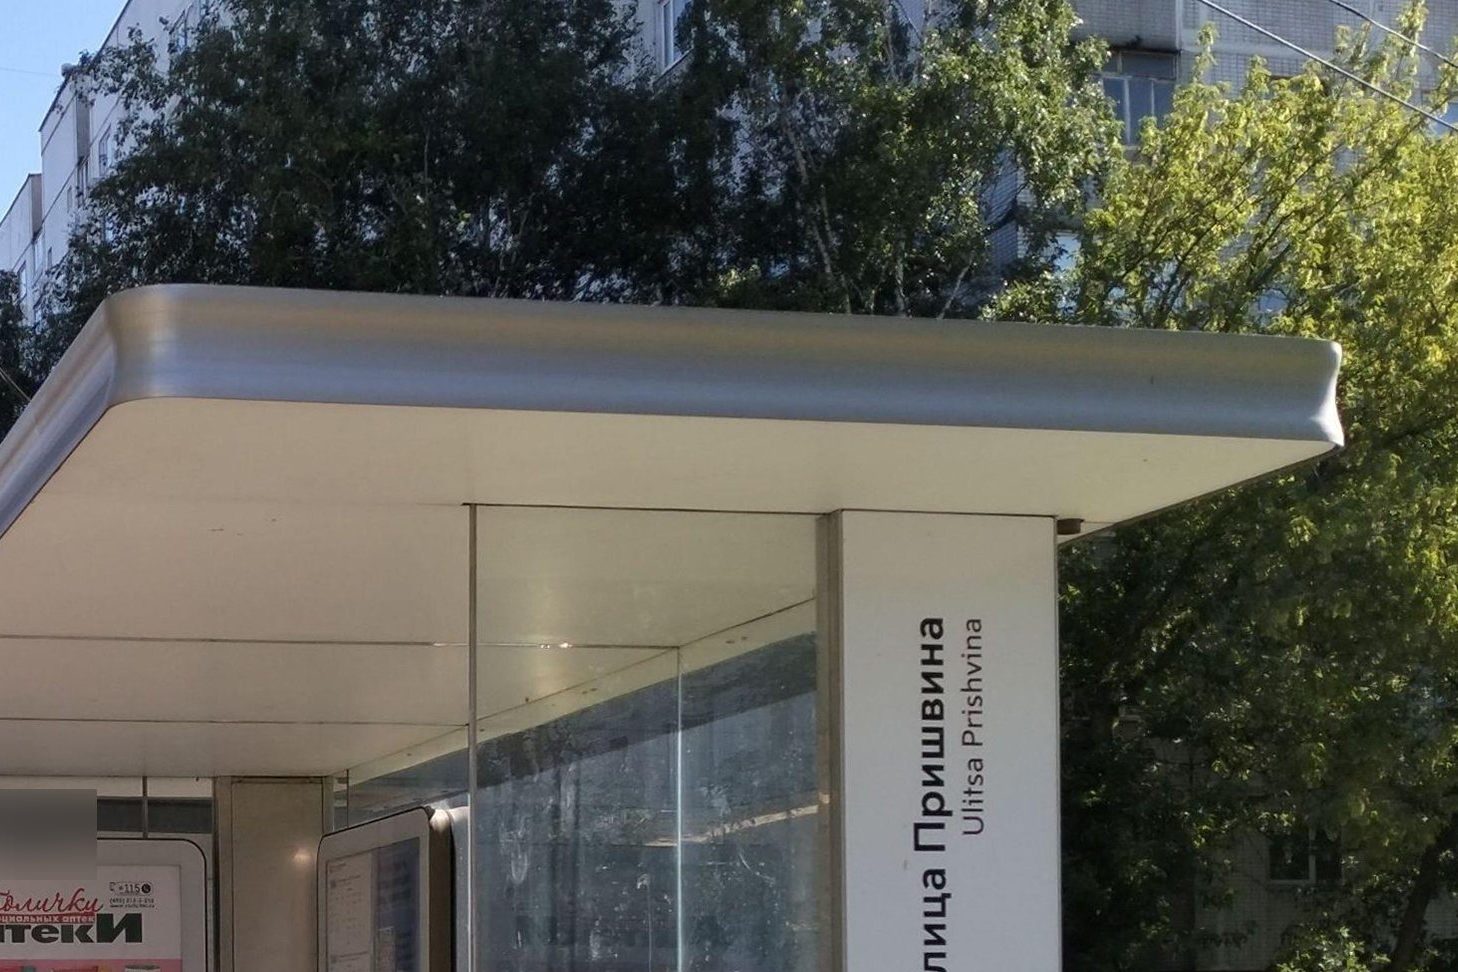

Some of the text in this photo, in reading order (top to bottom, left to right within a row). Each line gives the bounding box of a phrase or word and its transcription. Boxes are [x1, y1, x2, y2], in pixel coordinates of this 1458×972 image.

[914, 617, 953, 852] Пришвина
[961, 617, 985, 835] Ulitsa Prishvina
